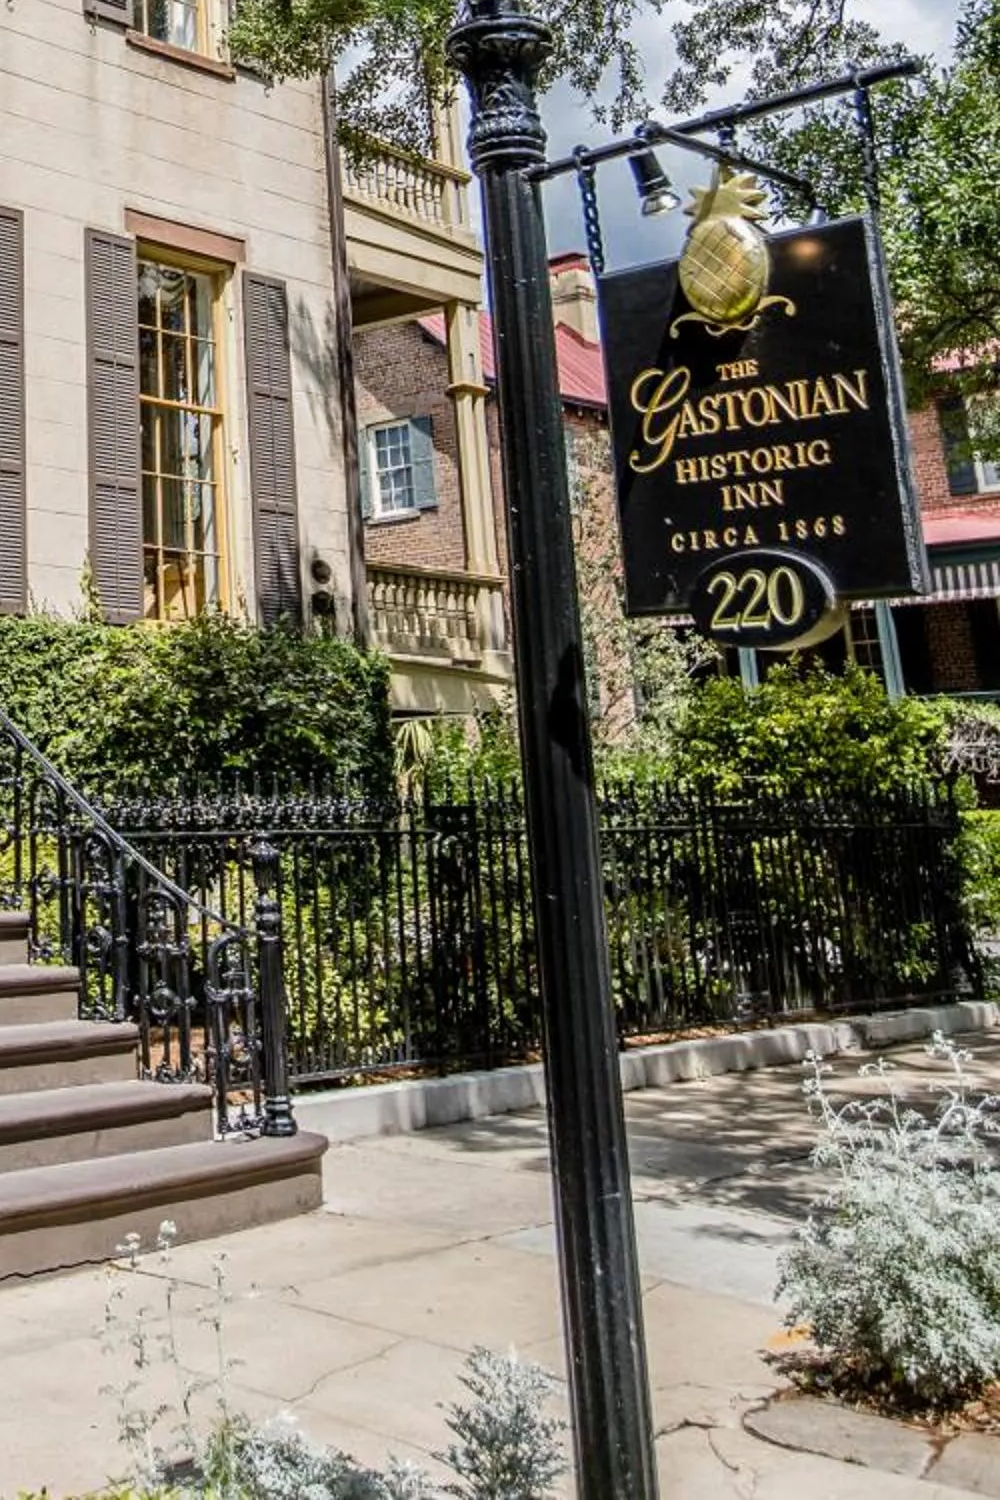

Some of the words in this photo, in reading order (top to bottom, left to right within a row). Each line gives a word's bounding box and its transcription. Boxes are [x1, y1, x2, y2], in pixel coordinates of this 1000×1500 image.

[715, 358, 760, 381] THE
[629, 366, 870, 474] GASTONIAN
[675, 439, 832, 484] HISTORIC
[720, 479, 784, 511] INN
[671, 525, 759, 551] CIRCA
[778, 515, 846, 541] 1868
[707, 566, 804, 632] 220
